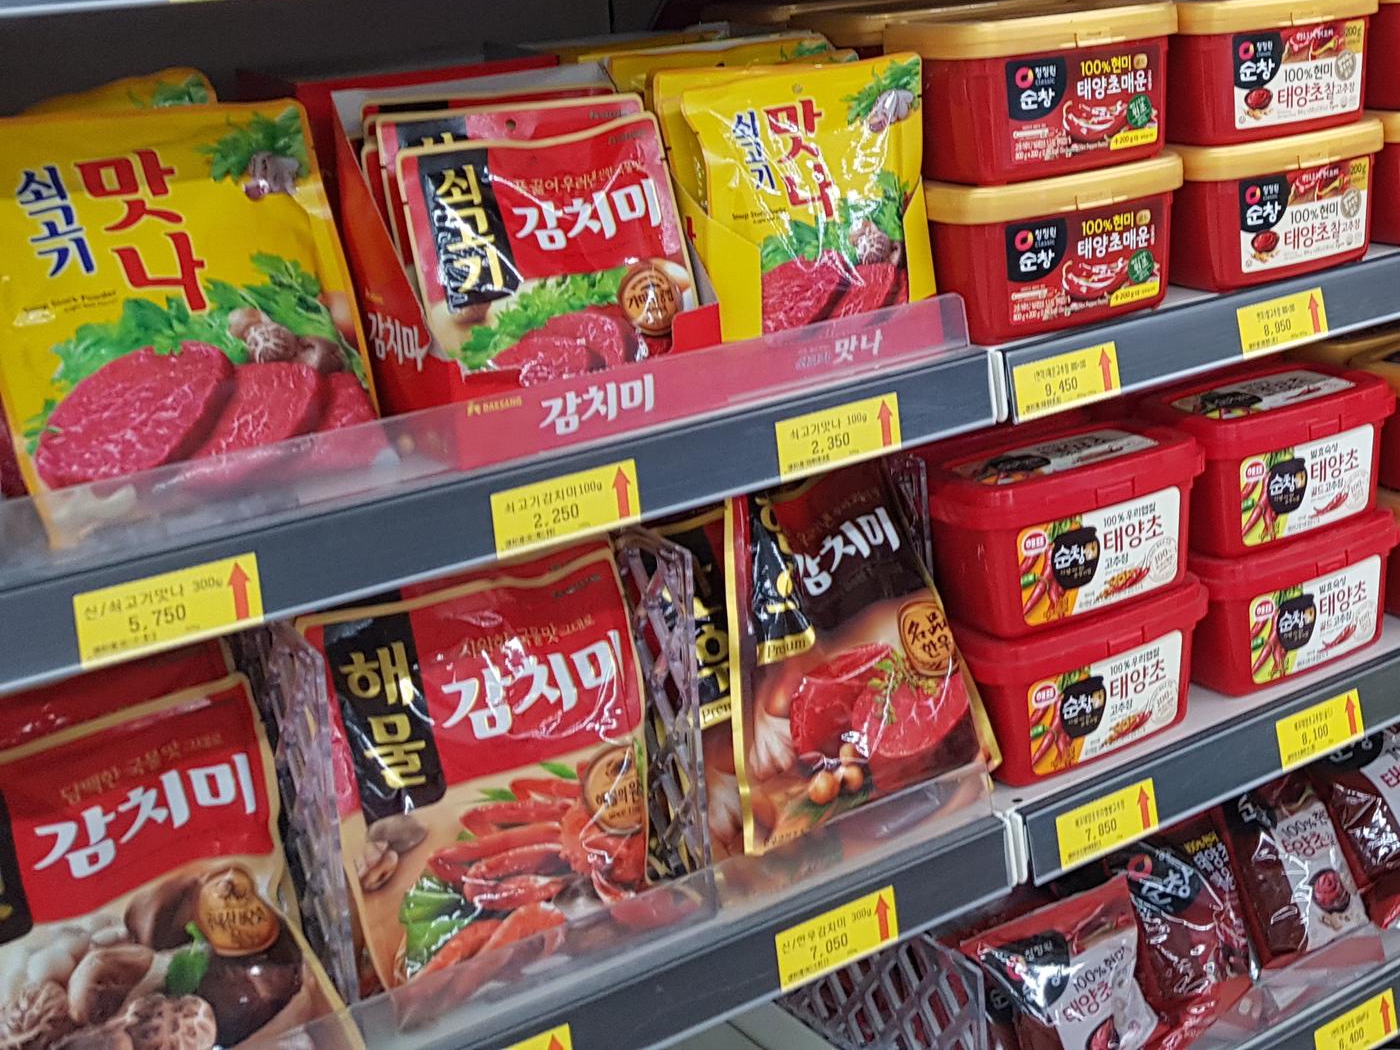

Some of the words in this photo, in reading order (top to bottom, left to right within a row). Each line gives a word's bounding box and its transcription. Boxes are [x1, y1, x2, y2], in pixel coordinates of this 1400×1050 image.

[1239, 57, 1275, 83] 순창
[1019, 88, 1056, 111] 순창
[16, 165, 95, 277] 쇠고기
[512, 178, 663, 250] 감치미
[1246, 200, 1282, 225] 순창
[74, 149, 208, 312] 맛나
[1018, 249, 1056, 273] 순창
[1262, 318, 1292, 337] 8,950
[834, 331, 884, 363] 맛나
[1044, 375, 1079, 394] 9,450
[540, 374, 655, 435] 감치미
[847, 413, 867, 426] 100g
[812, 432, 850, 455] 2,350
[1245, 464, 1265, 479] 해표
[1310, 449, 1360, 482] 태양초
[533, 503, 579, 529] 2,250
[1103, 513, 1125, 527] 100%
[1024, 534, 1045, 550] 해표
[1103, 515, 1165, 551] 태양초
[1104, 553, 1129, 570] 고추장
[1319, 582, 1368, 618] 태양초
[129, 604, 186, 633] 5,750
[441, 632, 626, 741] 감치미
[1109, 662, 1167, 699] 태양초
[1035, 688, 1056, 704] 해표
[338, 641, 430, 789] 해물
[1300, 726, 1329, 745] 8,100
[34, 753, 256, 879] 감치미
[1084, 817, 1118, 840] 7,850
[810, 933, 848, 960] 7,050
